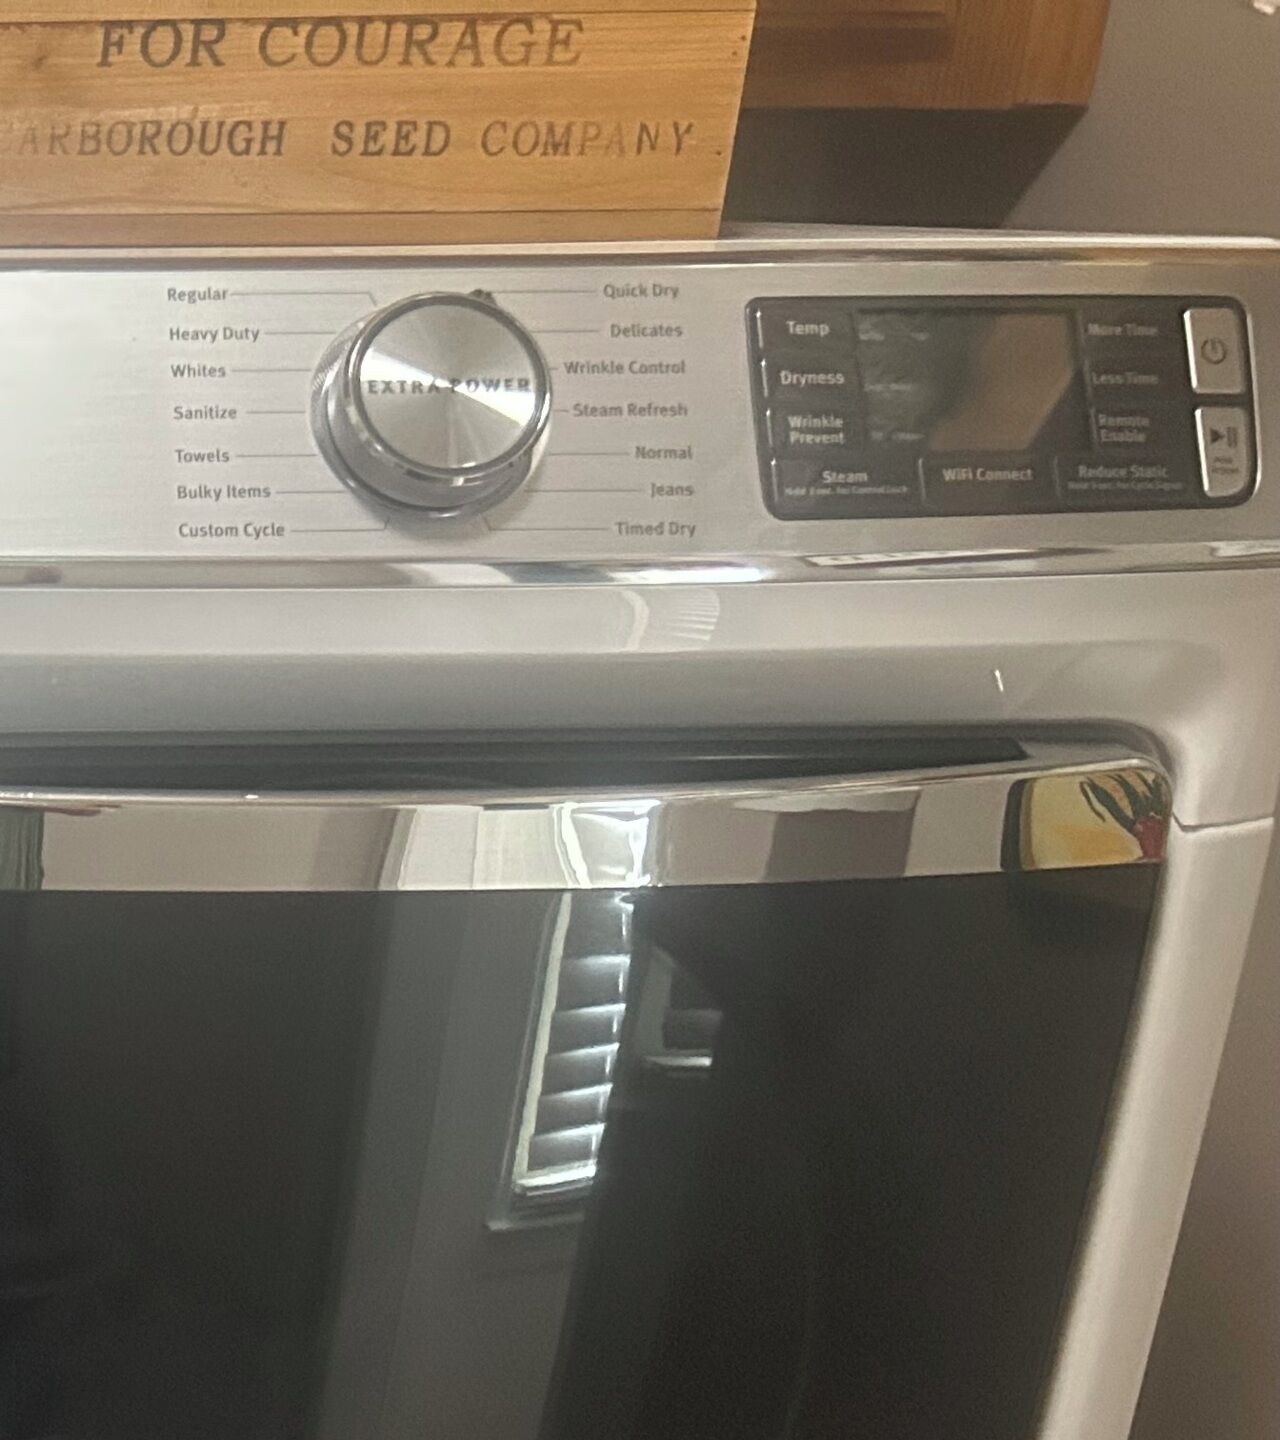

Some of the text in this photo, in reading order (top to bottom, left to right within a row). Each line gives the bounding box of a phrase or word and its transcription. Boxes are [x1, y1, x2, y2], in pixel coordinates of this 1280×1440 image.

[97, 18, 585, 68] FOR COURAGE
[332, 120, 450, 156] SEED
[482, 121, 693, 156] COMPANY
[167, 287, 228, 304] Regular
[603, 283, 679, 301] Quick Dry
[170, 326, 260, 344] Heavy Duty
[610, 323, 682, 338] Delicates
[787, 321, 829, 337] Temp
[1089, 322, 1158, 336] More Time
[170, 363, 226, 378] Whites
[565, 360, 685, 375] Wrinkle Control
[368, 378, 530, 394] EXTRA POWER
[781, 371, 845, 387] Dryness
[1093, 372, 1158, 385] Less Time
[173, 405, 237, 420] Sanitize
[573, 402, 687, 417] Steam Refresh
[788, 415, 843, 429] Wrinkle
[790, 430, 844, 444] Prevent
[1100, 429, 1146, 443] Enable
[176, 449, 229, 463] Towels
[636, 445, 692, 460] Normal
[823, 470, 868, 483] Steam
[943, 468, 1033, 481] WiFi Connect
[1079, 464, 1167, 479] Reduce Static
[178, 484, 270, 501] Bulky Items
[650, 483, 694, 498] Jeans
[179, 523, 284, 541] Custom Cycle
[616, 522, 696, 540] Timed Dry
